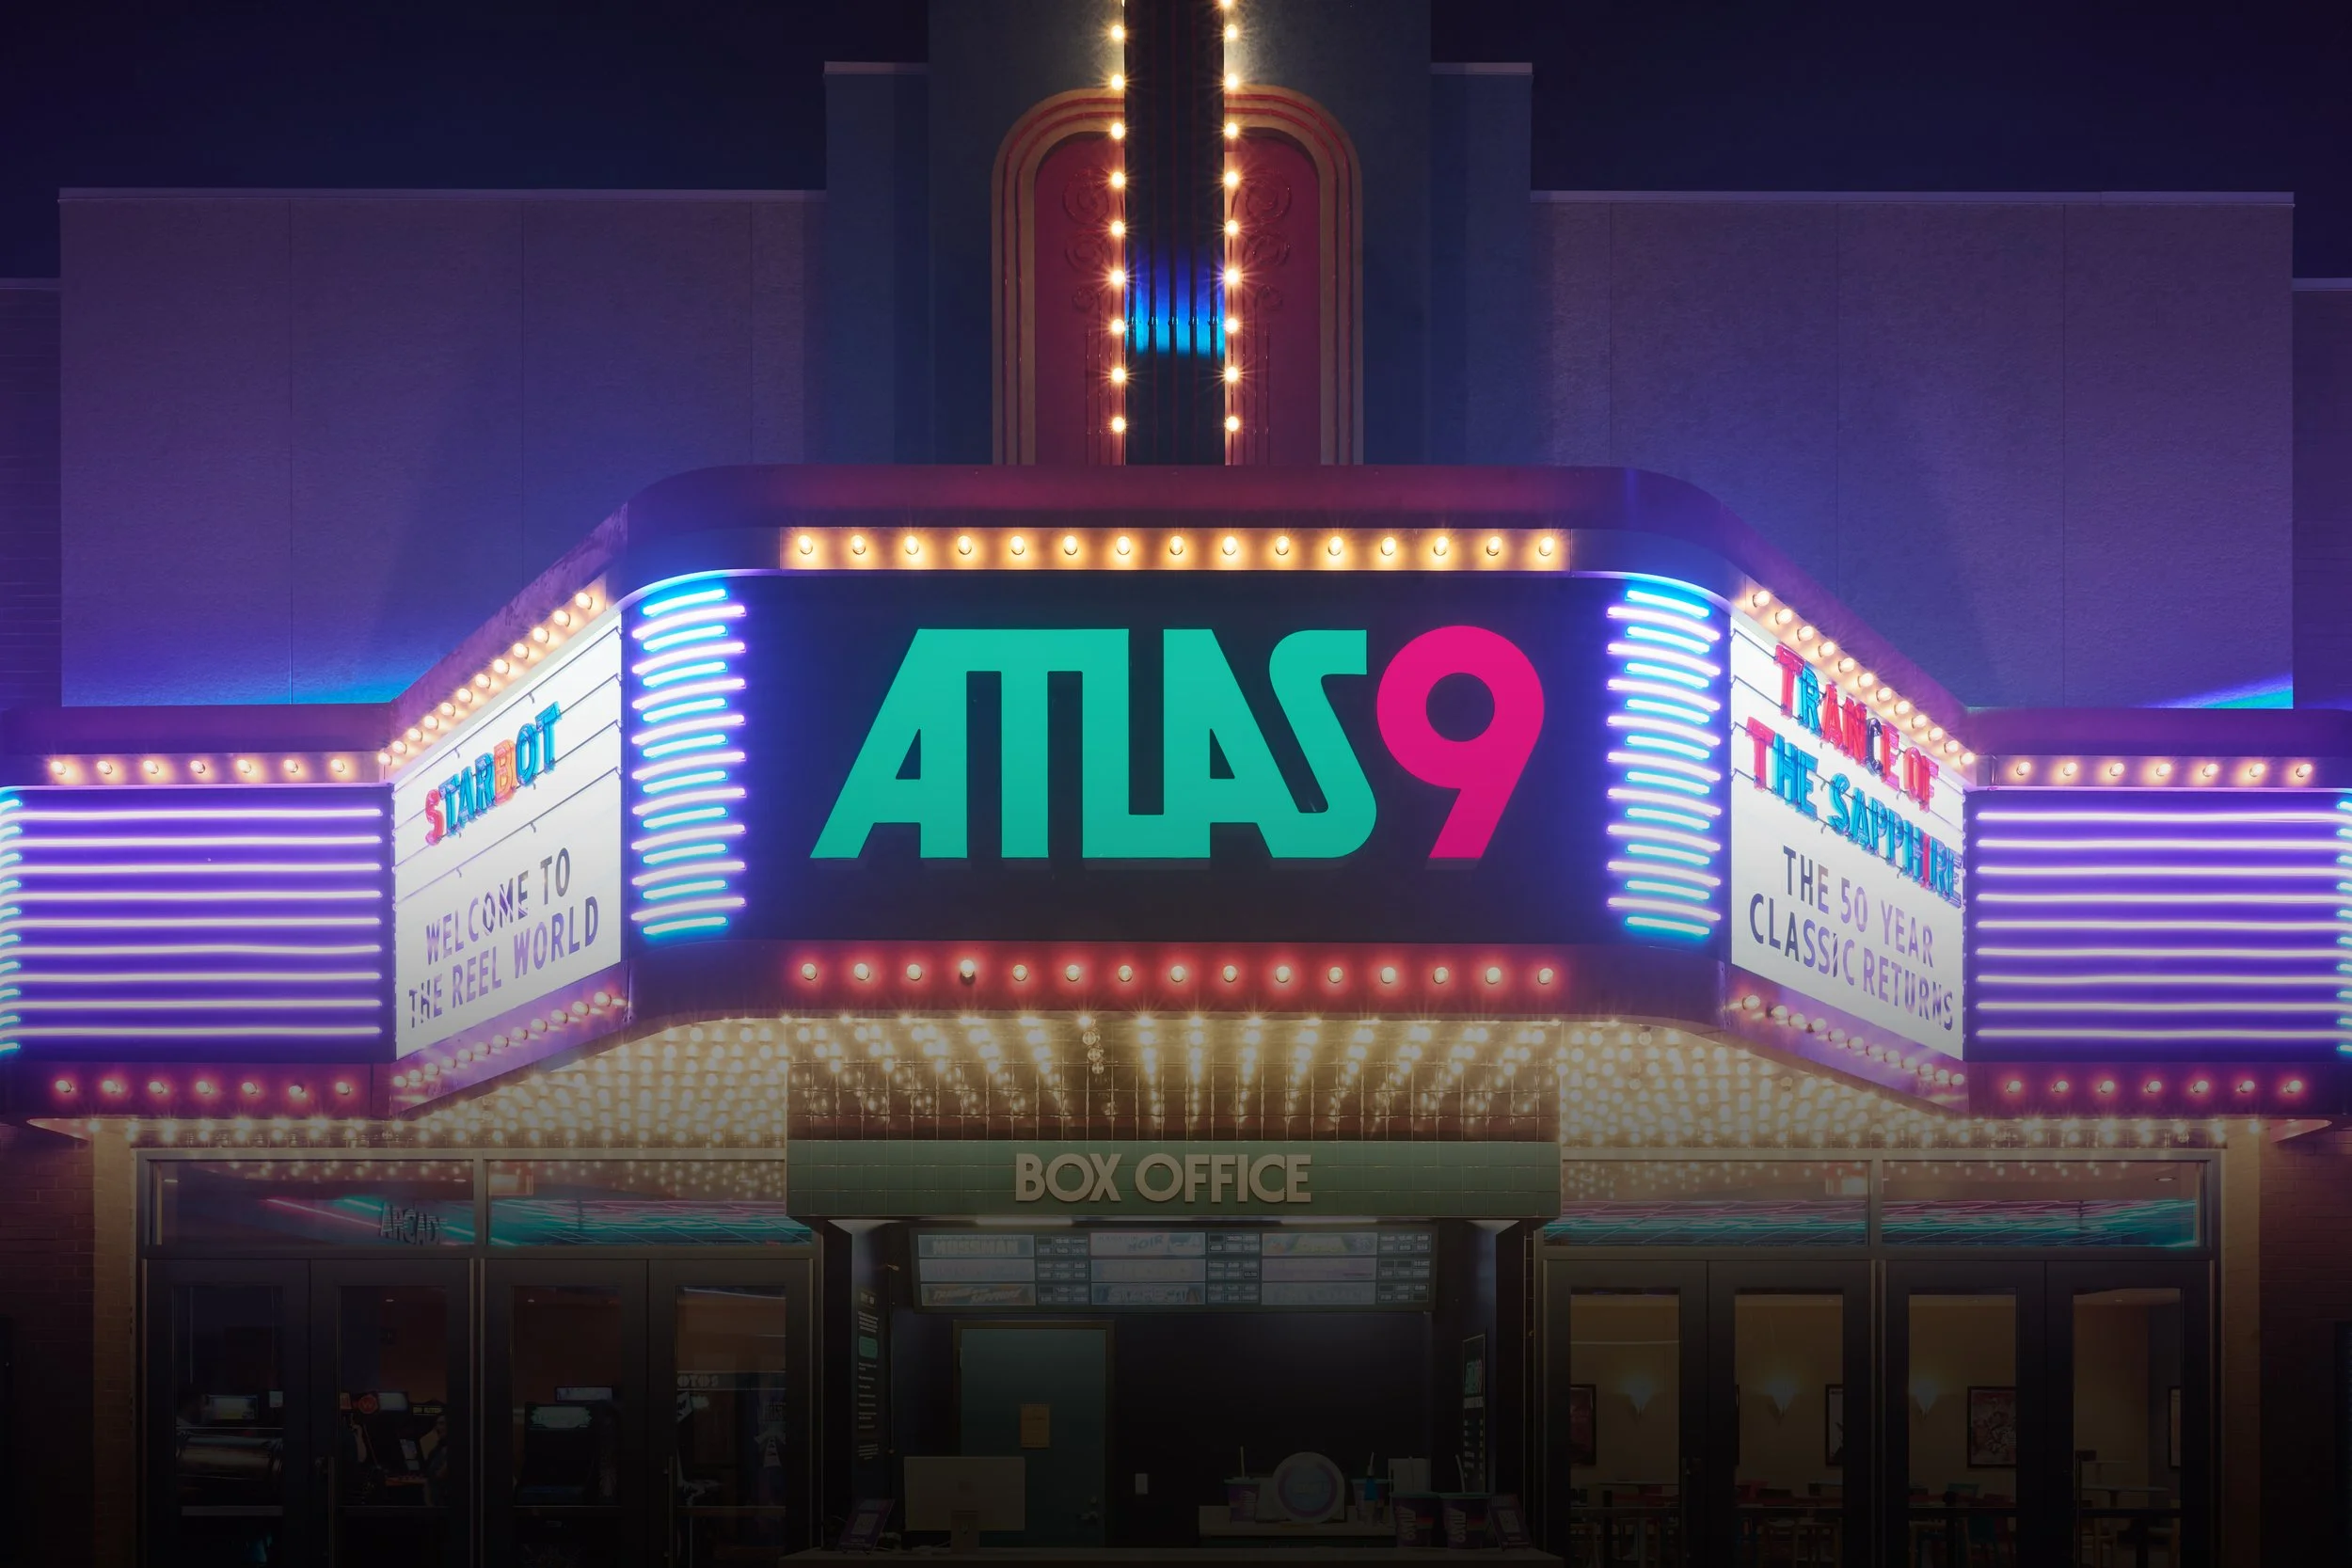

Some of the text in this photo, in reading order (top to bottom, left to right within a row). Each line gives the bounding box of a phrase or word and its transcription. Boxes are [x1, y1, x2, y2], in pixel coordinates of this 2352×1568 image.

[424, 700, 563, 846] STARBOT
[1774, 641, 1939, 813] TRANCE OF
[1746, 716, 1963, 909] THE SAPPHIRE
[408, 900, 599, 1028] THE REEL WORLD
[425, 847, 571, 966] WELCOME TO
[1749, 893, 1953, 1032] CLASSIC RETURNS
[1783, 845, 1933, 969] THE 50 YEAR
[1016, 1153, 1311, 1203] BOX OFFICE
